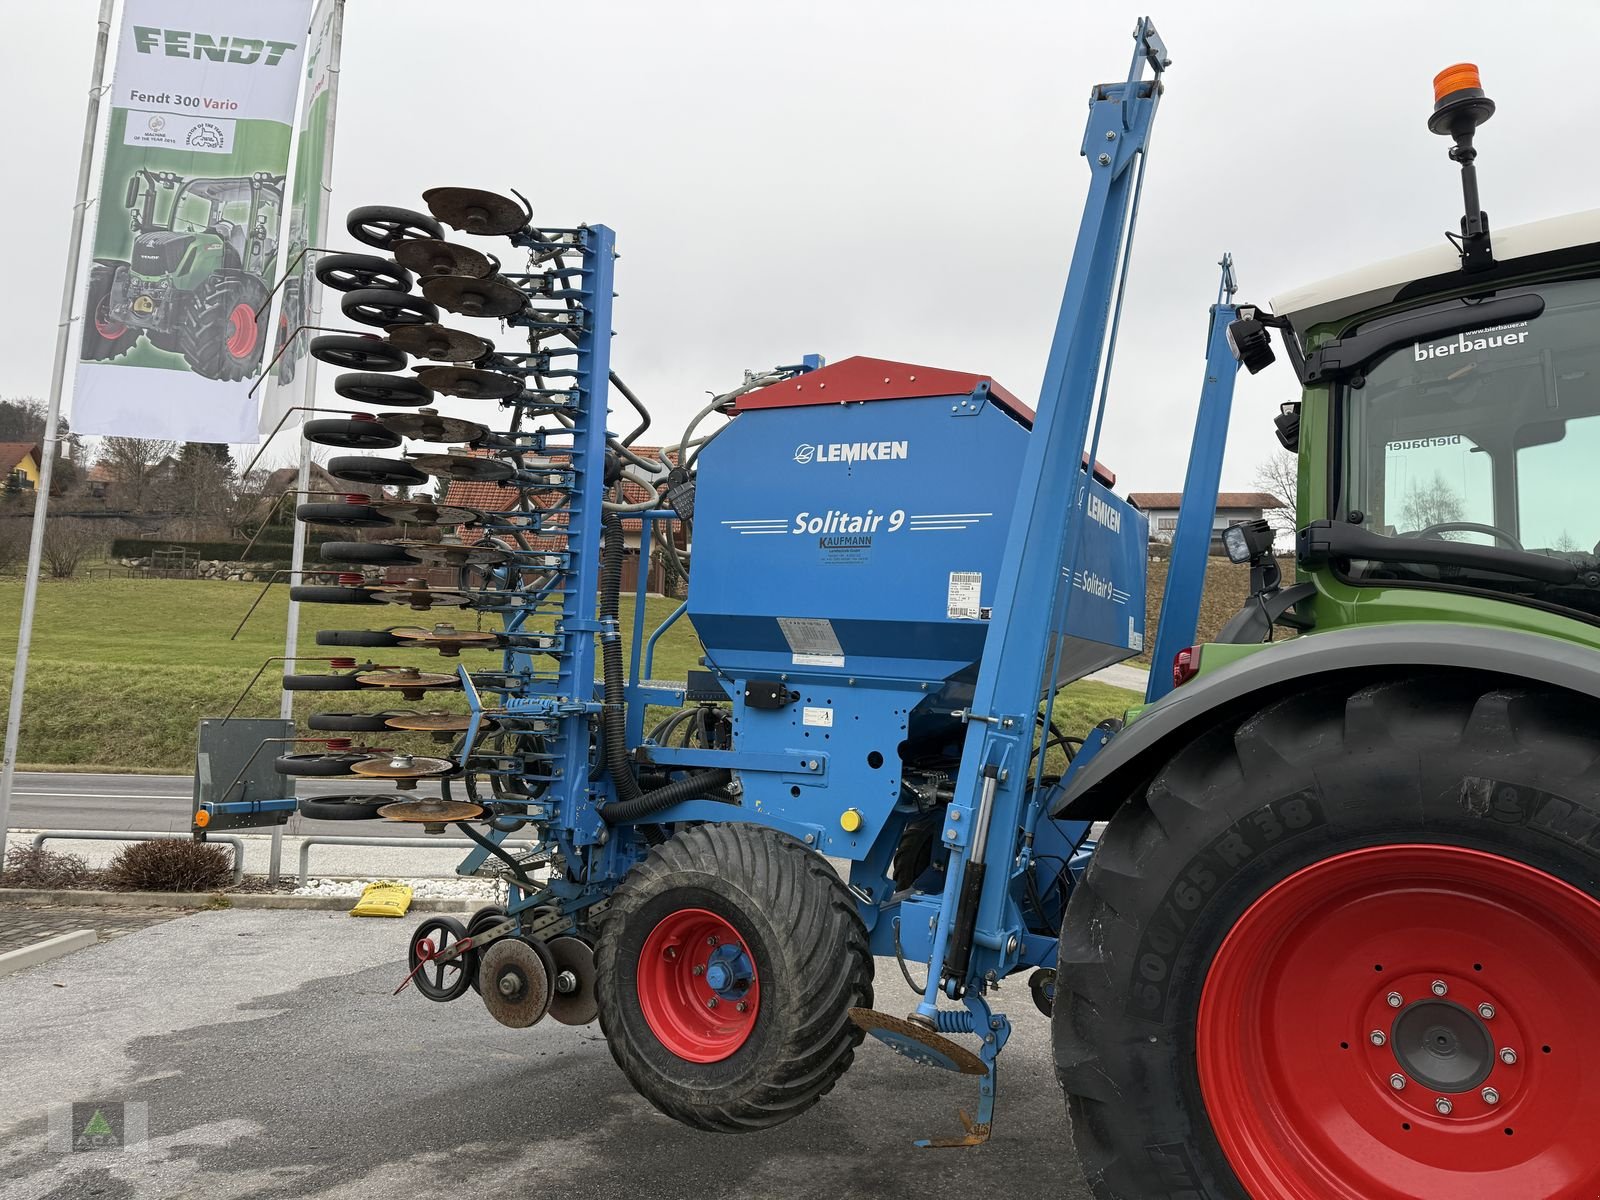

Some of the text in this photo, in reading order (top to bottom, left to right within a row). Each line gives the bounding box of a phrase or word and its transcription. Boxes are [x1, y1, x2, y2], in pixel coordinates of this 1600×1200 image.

[133, 25, 298, 66] FENDT
[130, 89, 238, 111] Fendt 300 Vario
[1465, 321, 1528, 336] www.bierbauer.at
[1414, 331, 1529, 362] bierbauer
[816, 440, 908, 465] LEMKEN
[792, 509, 906, 535] Solitair 9
[1087, 492, 1121, 534] LEMKEN
[819, 536, 872, 549] KAUFMANN
[1081, 569, 1113, 600] Solitair 9
[1214, 831, 1254, 867] R
[1254, 798, 1314, 842] 38
